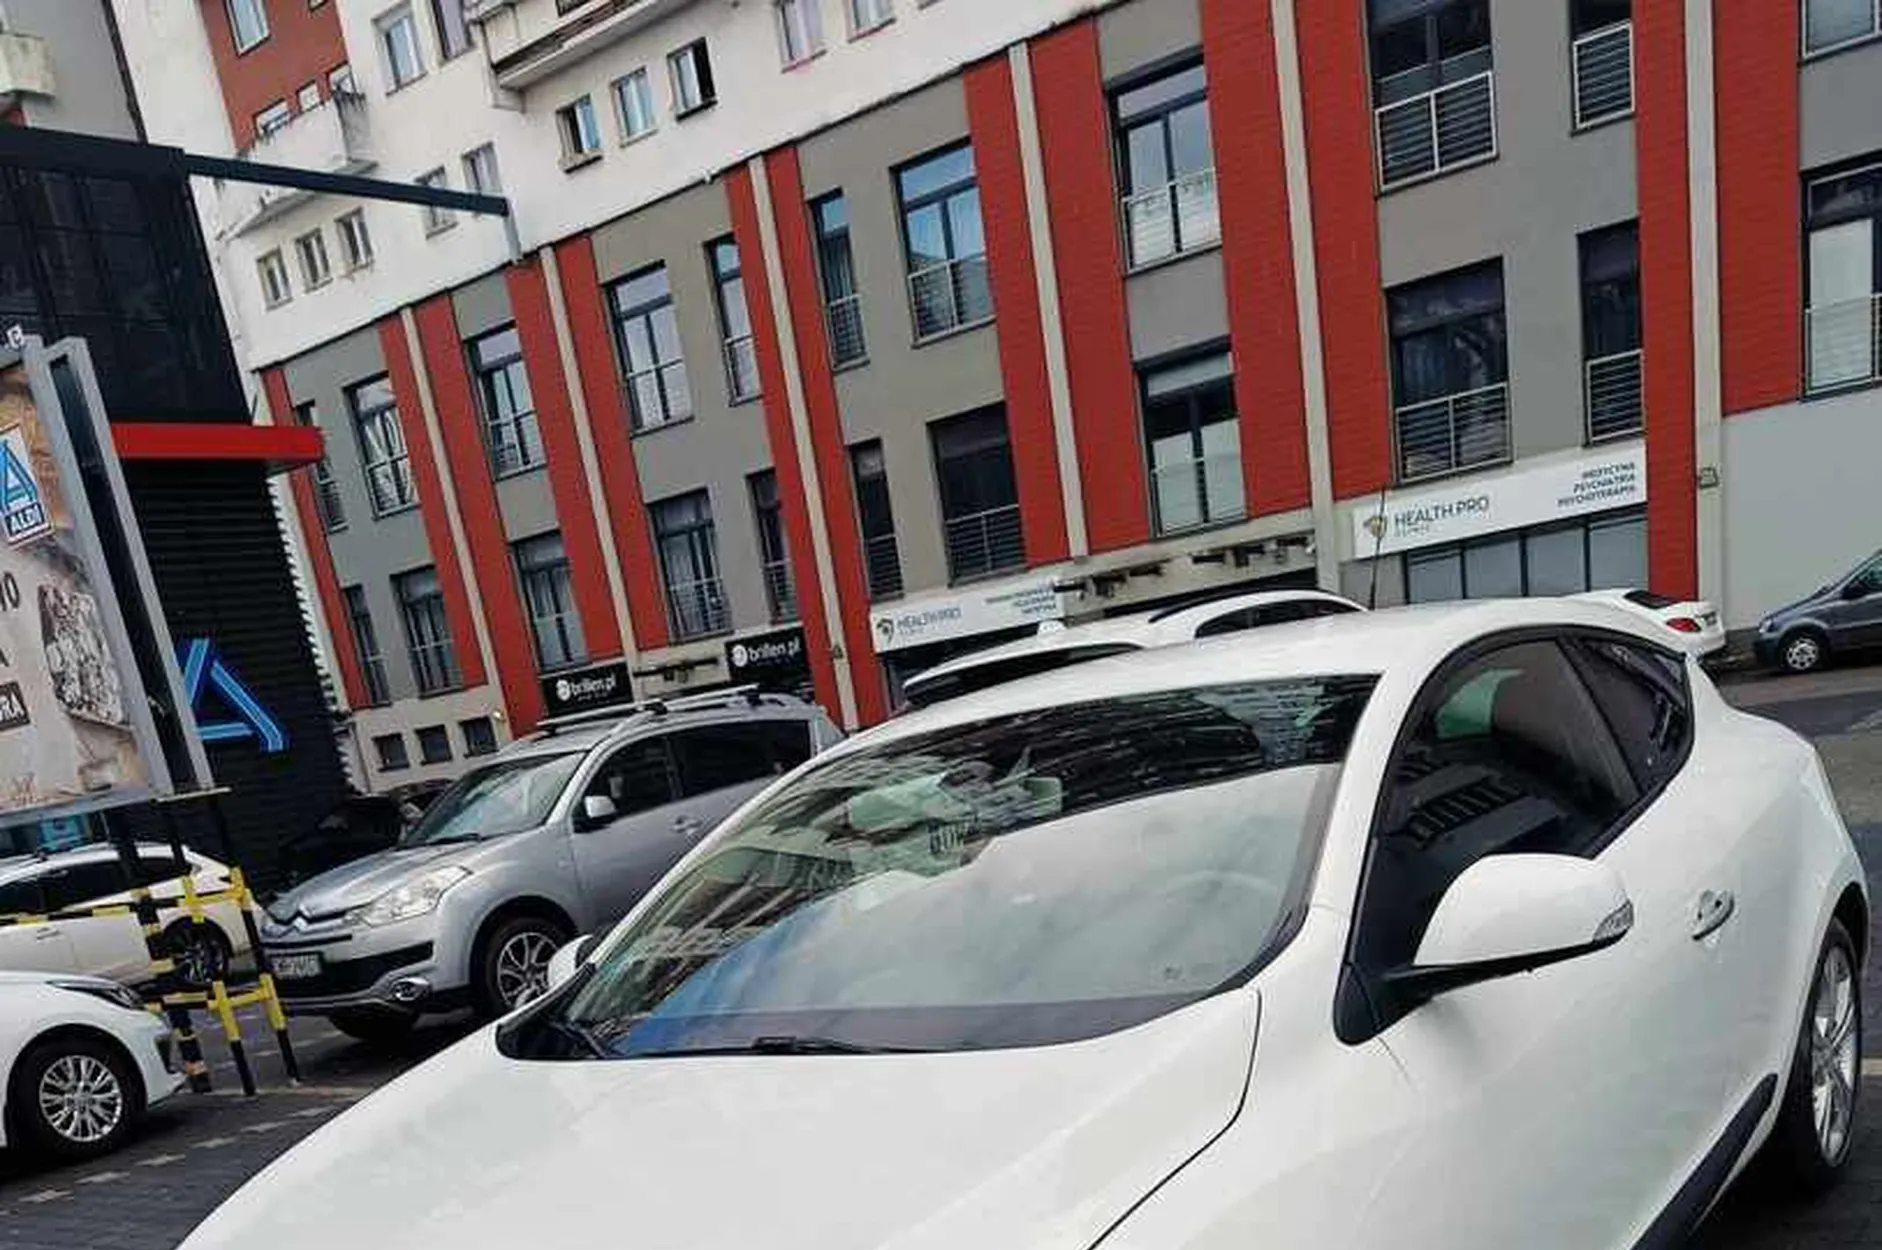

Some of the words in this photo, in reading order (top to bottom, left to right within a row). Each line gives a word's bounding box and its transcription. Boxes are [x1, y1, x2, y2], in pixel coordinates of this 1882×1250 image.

[9, 503, 43, 533] ALDI
[1395, 503, 1453, 525] HEALTH
[1455, 497, 1490, 515] PRO
[748, 637, 800, 660] brillen.pl
